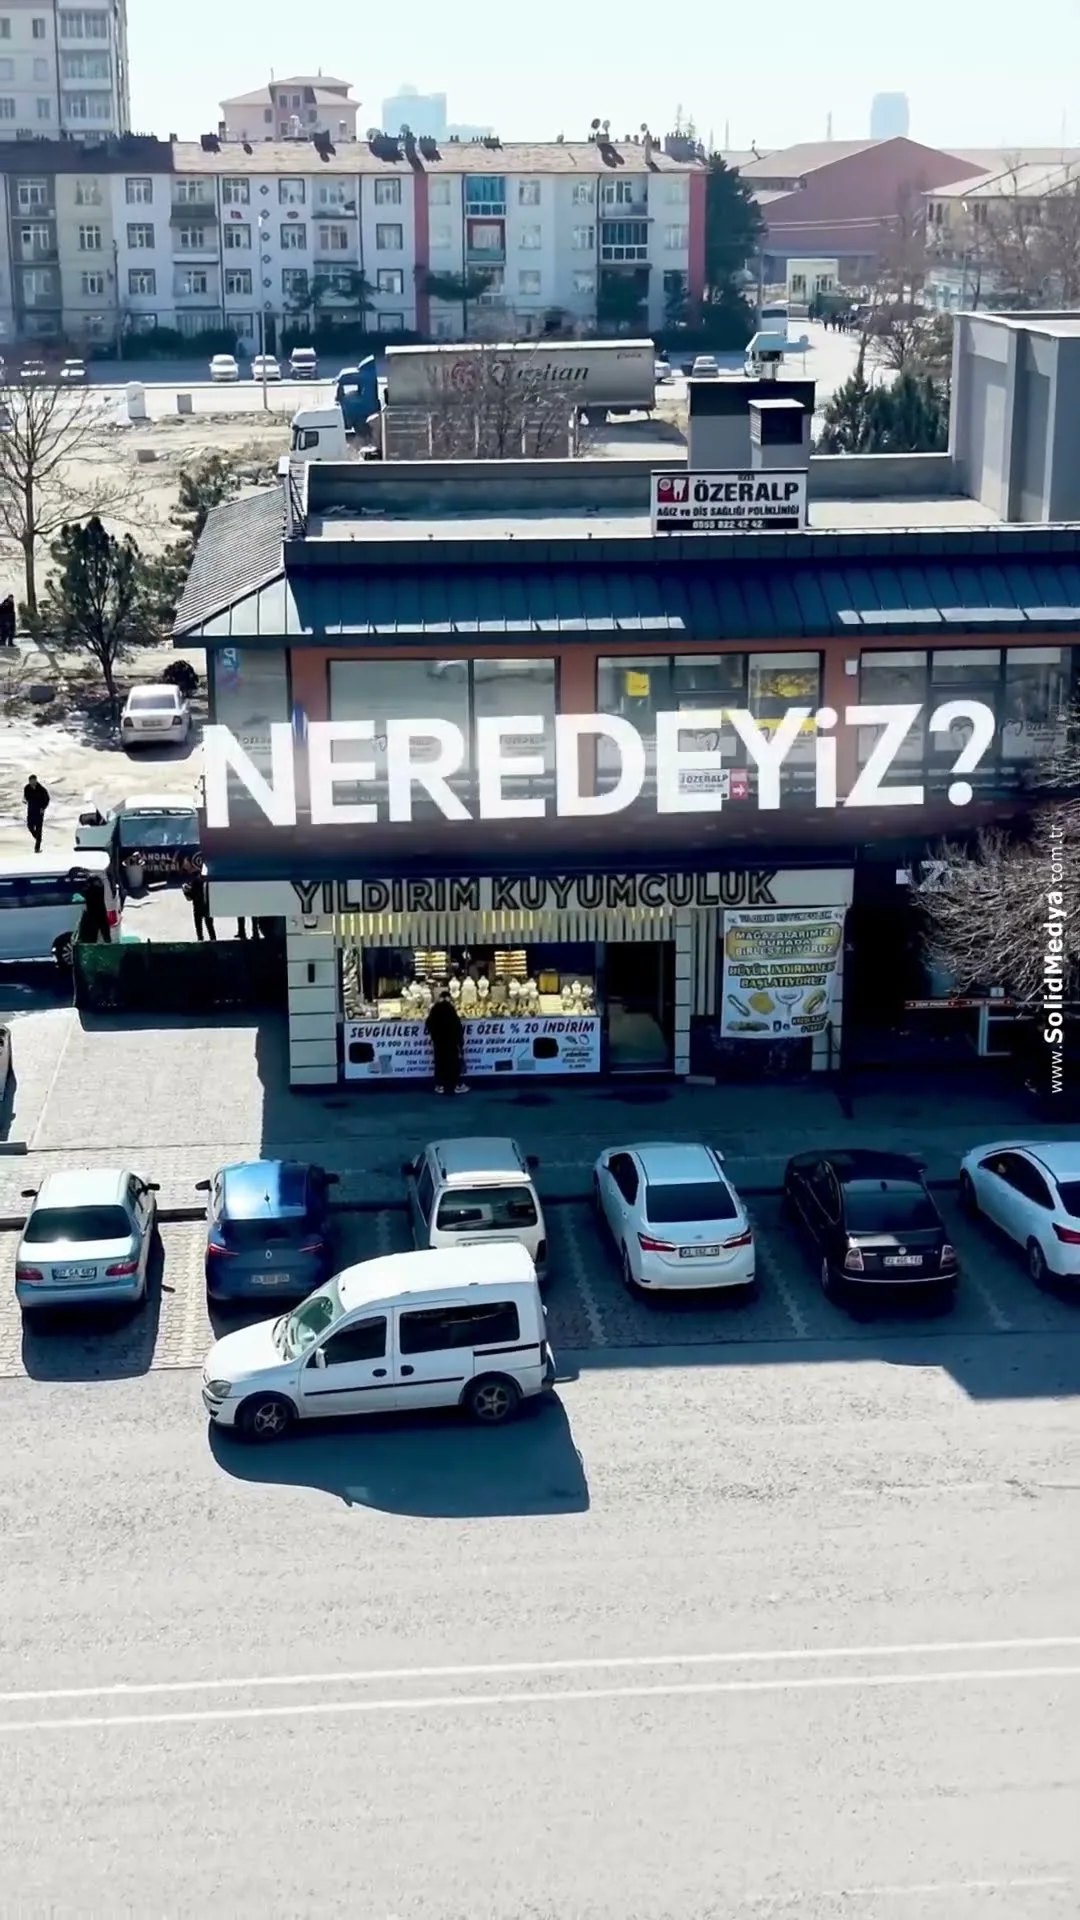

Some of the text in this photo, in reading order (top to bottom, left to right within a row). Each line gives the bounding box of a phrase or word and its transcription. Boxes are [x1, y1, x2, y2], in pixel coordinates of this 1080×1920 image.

[694, 480, 799, 502] ÖZERALP
[657, 506, 678, 516] AĞIZ
[710, 505, 745, 516] SAĞLIĞI
[290, 870, 777, 914] YILDIRIM KUYUMCULUK
[735, 928, 834, 940] MAĞAZALARIMIZI
[758, 939, 811, 947] BURADA
[728, 964, 769, 976] BÜYÜK
[739, 976, 827, 989] BAŞLATIYORUZ
[350, 1024, 420, 1038] SEVGİLİLER
[477, 1021, 505, 1035] ÖZEL
[510, 1023, 519, 1034] %
[524, 1022, 539, 1034] 20
[543, 1019, 595, 1033] İNDİRİM
